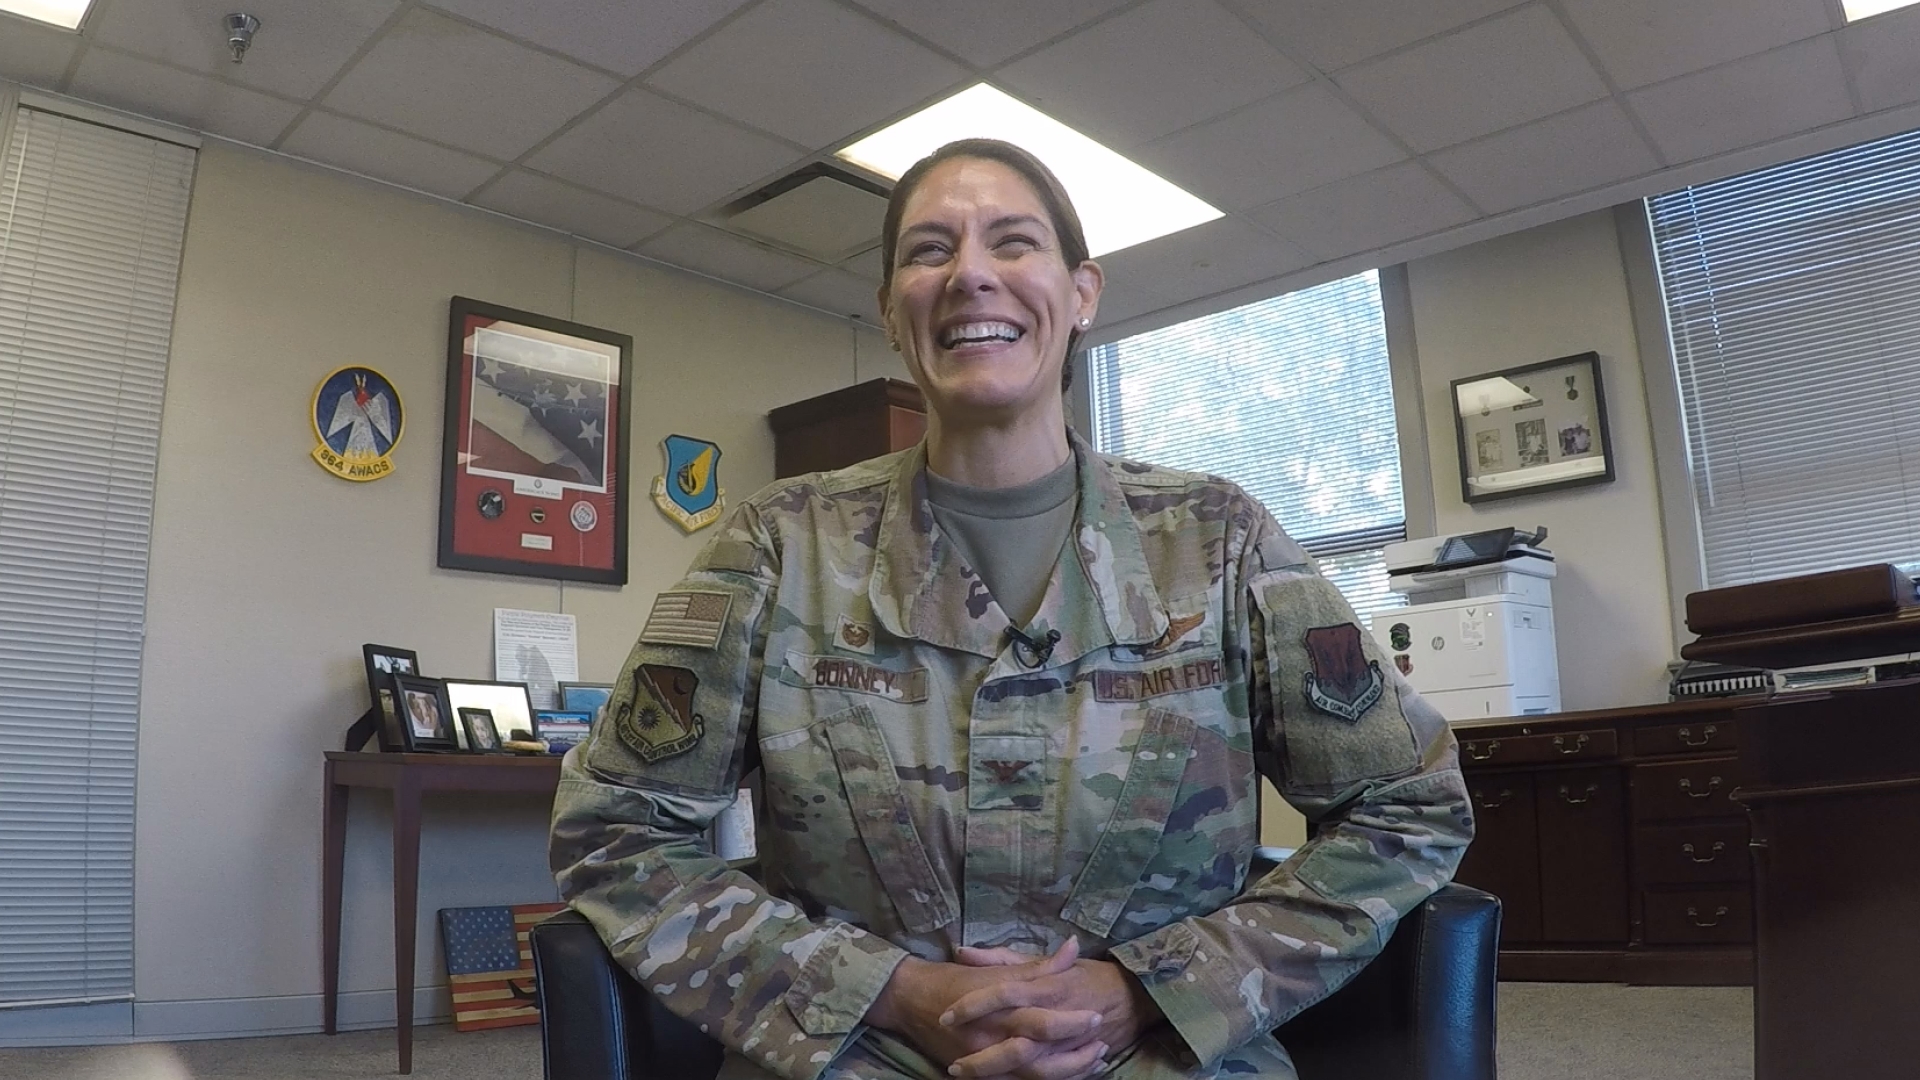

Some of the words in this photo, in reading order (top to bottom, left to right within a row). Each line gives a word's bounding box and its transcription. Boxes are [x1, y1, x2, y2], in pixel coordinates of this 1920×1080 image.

[319, 449, 344, 472] 964
[348, 460, 389, 477] AWACS
[815, 659, 896, 694] BONNEY
[1141, 666, 1178, 698] AIR
[1182, 659, 1222, 688] FOR
[1314, 695, 1329, 709] AIR
